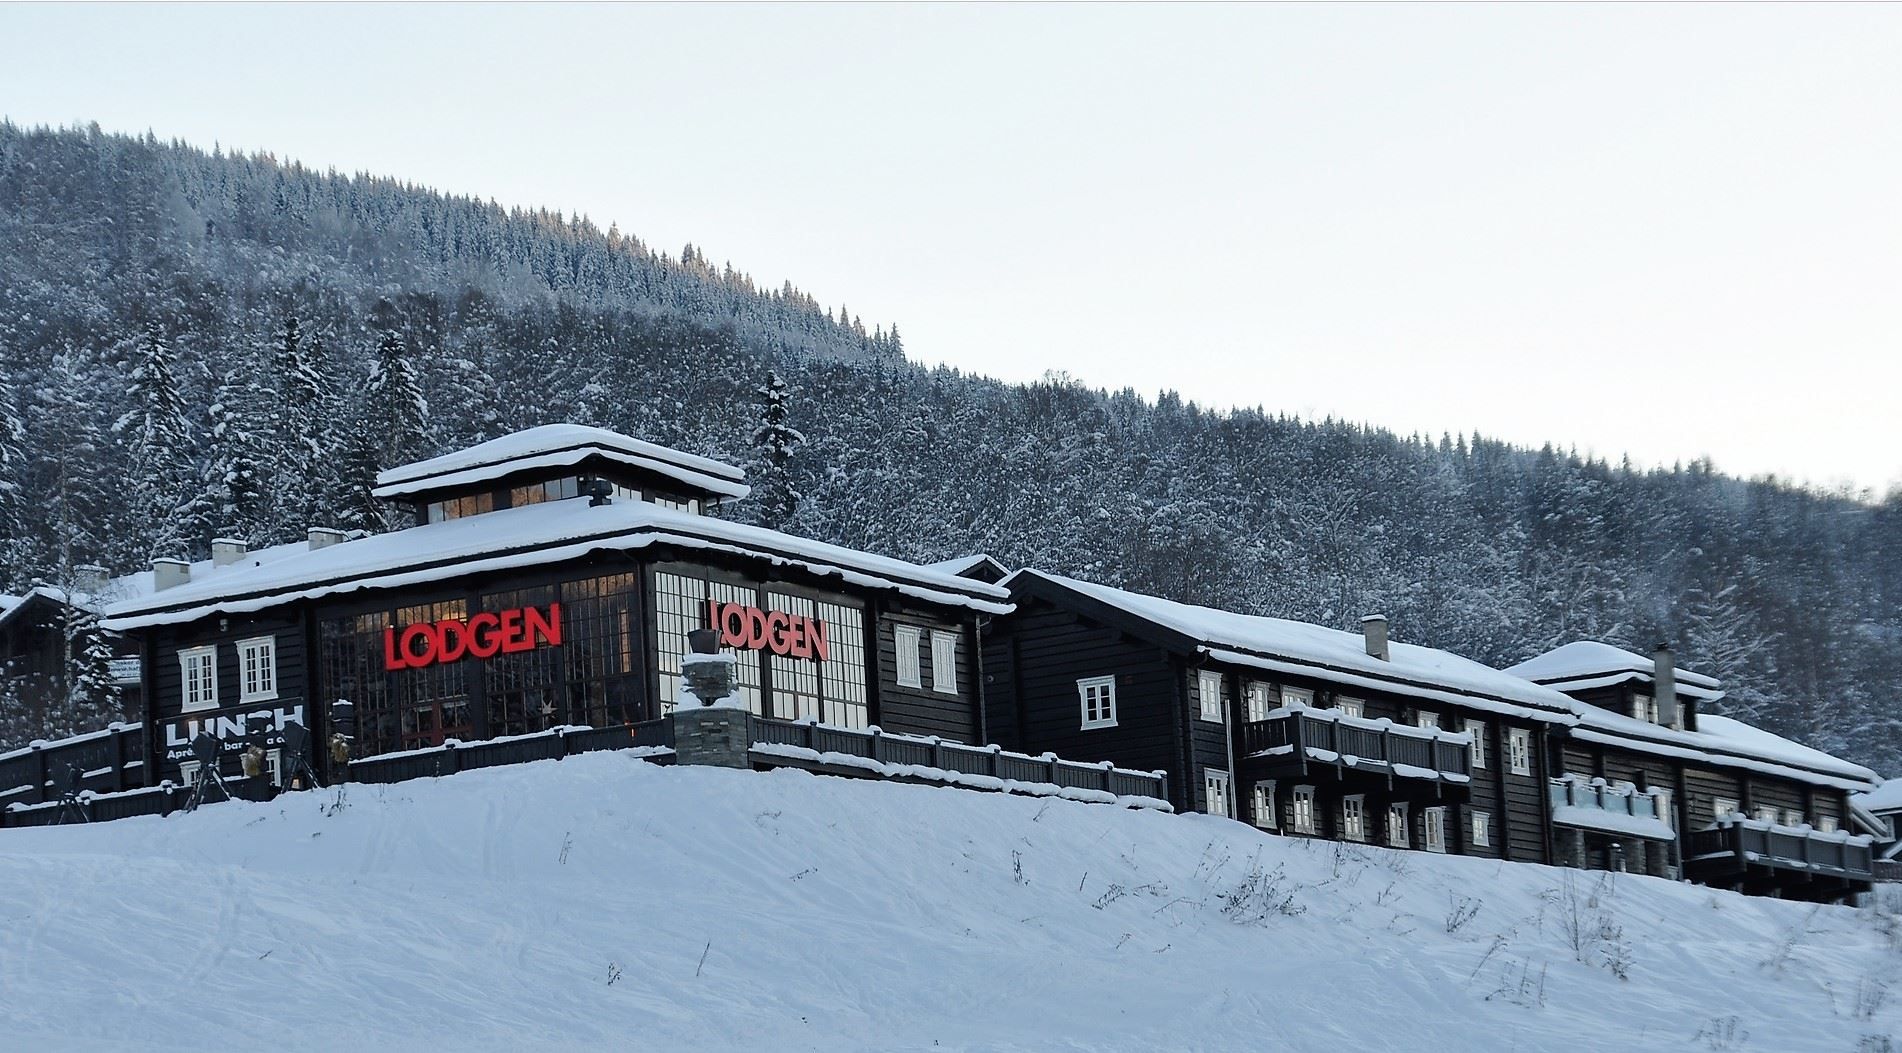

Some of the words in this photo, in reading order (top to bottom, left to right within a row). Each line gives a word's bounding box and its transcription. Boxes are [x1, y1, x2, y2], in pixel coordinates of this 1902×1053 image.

[384, 602, 563, 671] LODGEN
[710, 600, 829, 661] LODGEN
[224, 740, 243, 751] bar
